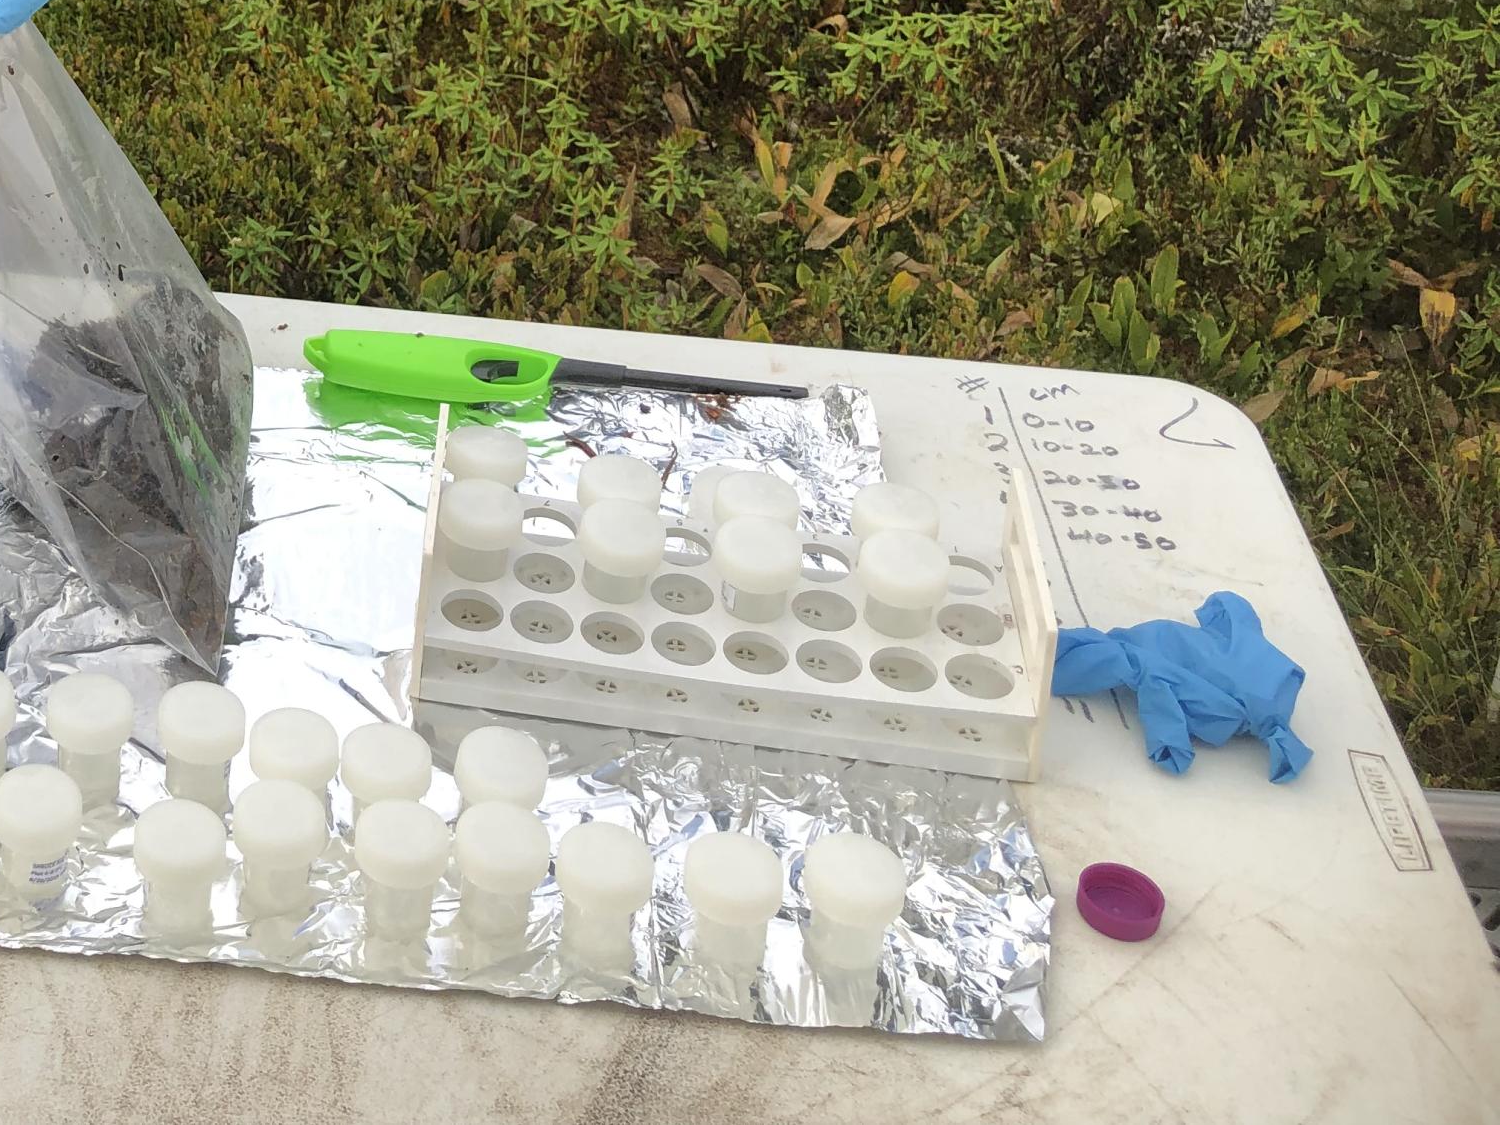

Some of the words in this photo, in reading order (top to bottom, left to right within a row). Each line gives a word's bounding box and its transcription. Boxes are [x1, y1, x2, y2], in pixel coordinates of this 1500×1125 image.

[984, 405, 994, 425] 1
[1022, 412, 1094, 432] 0-10
[984, 433, 1009, 452] 2
[1031, 437, 1118, 457] 10-20
[1052, 500, 1162, 523] 30-40
[1068, 527, 1177, 551] 40-50
